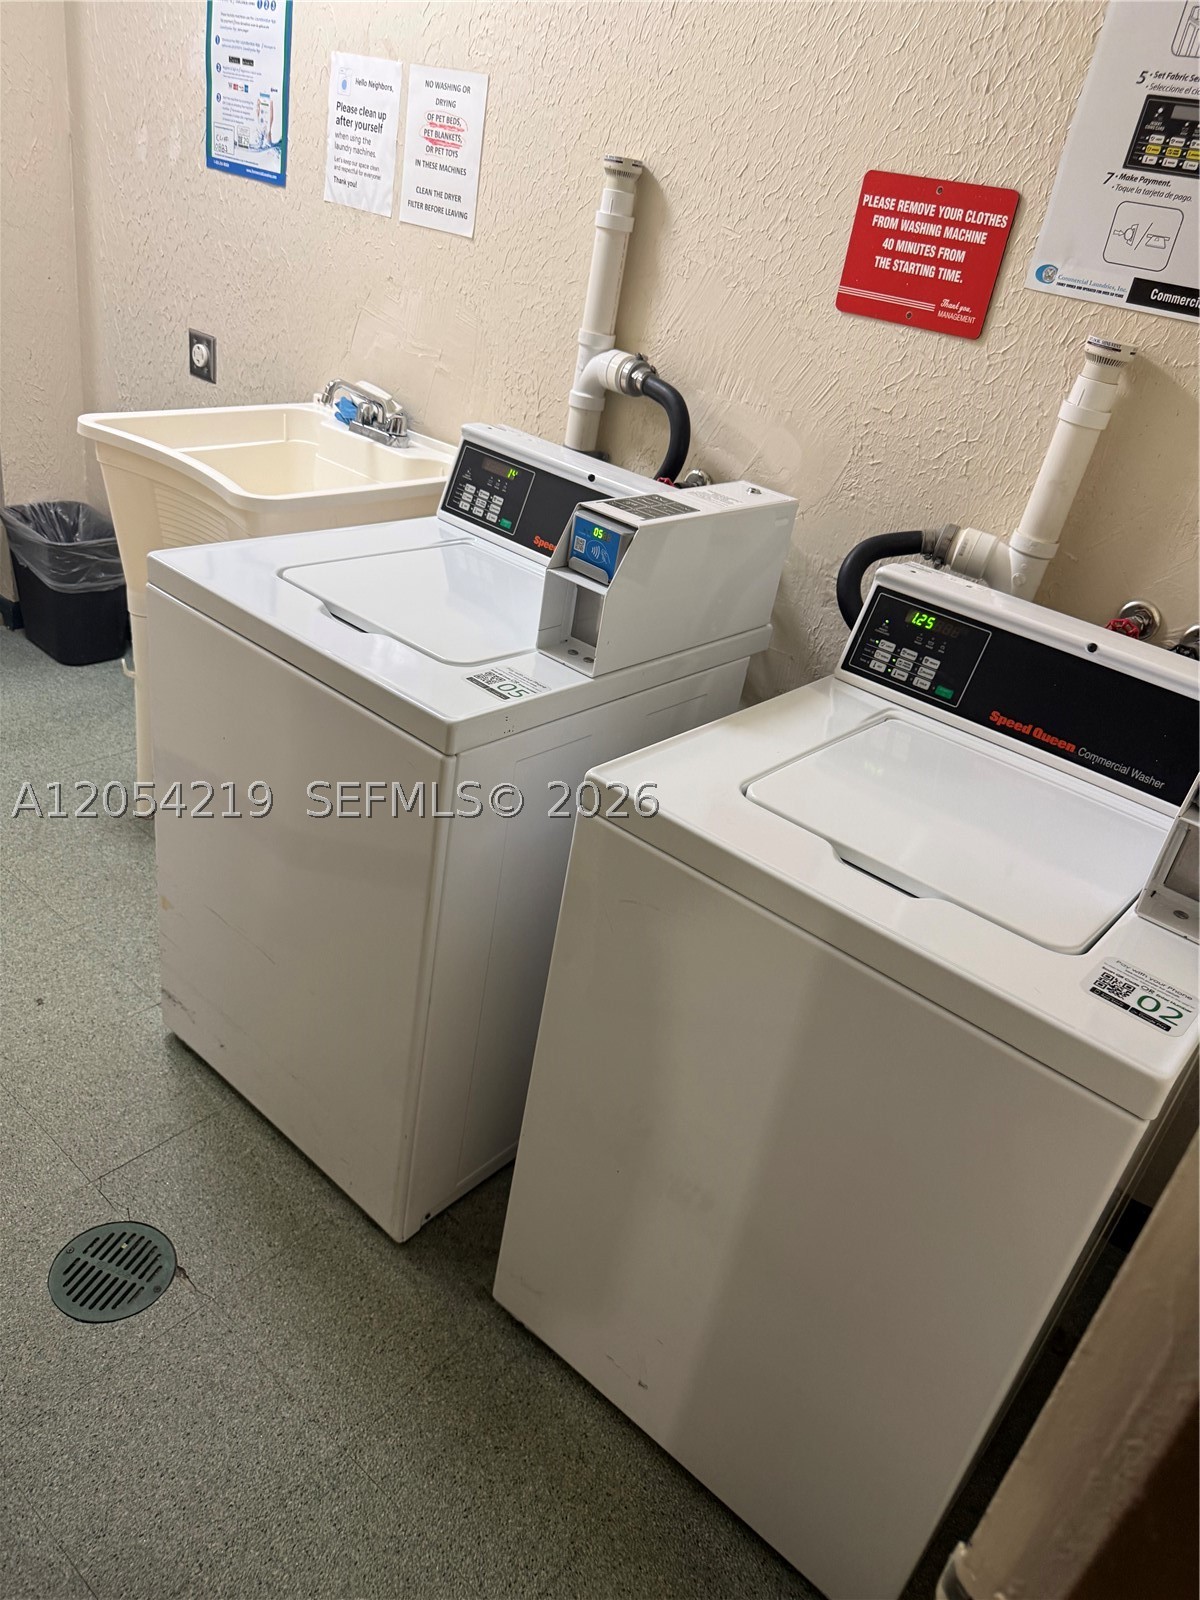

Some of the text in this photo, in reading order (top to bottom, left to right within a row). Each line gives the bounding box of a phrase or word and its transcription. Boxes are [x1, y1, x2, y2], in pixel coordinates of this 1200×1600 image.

[1136, 70, 1149, 84] 5
[1154, 71, 1165, 81] Set
[1166, 72, 1189, 82] Fabric
[355, 78, 394, 93] Hello Neighbors,
[425, 80, 471, 94] NO WASHING OR
[1150, 83, 1184, 93] Seleccione
[436, 98, 456, 108] DRYING
[336, 100, 387, 122] Please clean up
[336, 115, 383, 134] after yourself
[436, 114, 445, 123] PET
[446, 116, 461, 127] BEDS,
[335, 131, 371, 146] when using the
[424, 129, 462, 143] PET BLANKETS,
[335, 141, 352, 154] laundry
[426, 145, 458, 158] OR PET TOYS
[415, 159, 466, 176] IN THESE MACHINES
[334, 175, 346, 185] Thank
[1103, 172, 1115, 184] 7
[1119, 173, 1171, 187] Make Payment.
[416, 186, 462, 203] CLEAN THE DRYER
[1115, 184, 1135, 193] Toque
[1135, 186, 1141, 194] la
[1142, 188, 1163, 198] tarjeta
[1164, 191, 1173, 199] de
[408, 200, 468, 220] FILTER BEFORE LEAVING
[862, 194, 1009, 229] PLEASE REMOVE YOUR CLOTHES
[872, 214, 988, 245] FROM WASHING MACHINE
[882, 238, 966, 263] 40 MINUTES FROM
[874, 256, 963, 284] THE STARTING TIME.
[1058, 274, 1088, 285] Commercial
[940, 298, 972, 313] Thank you,
[937, 310, 976, 324] MANAGEMENT
[592, 527, 604, 538] 05
[533, 535, 556, 552] Spee
[497, 683, 530, 698] 05
[989, 710, 1166, 790] Speed Queen Commercial Washer
[1132, 968, 1148, 978] with
[1149, 977, 1166, 988] your
[1167, 986, 1193, 1000] Phone
[1141, 985, 1155, 994] OR
[1136, 994, 1184, 1026] 02
